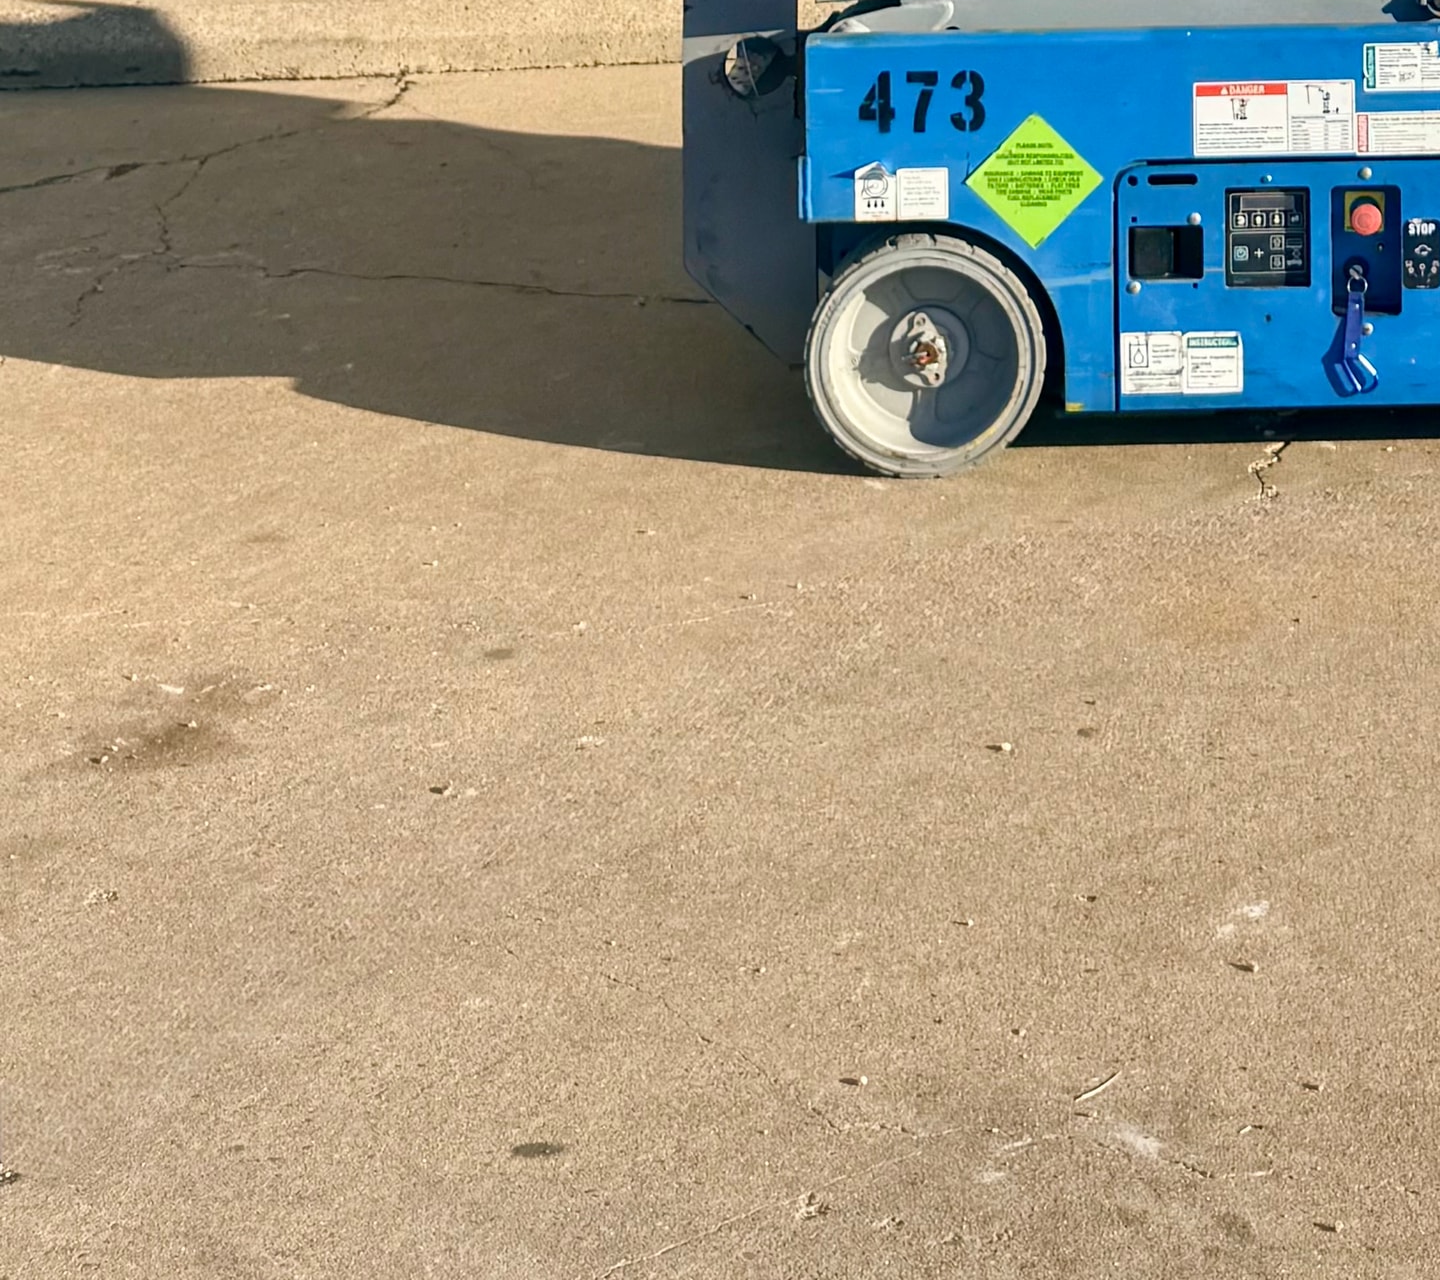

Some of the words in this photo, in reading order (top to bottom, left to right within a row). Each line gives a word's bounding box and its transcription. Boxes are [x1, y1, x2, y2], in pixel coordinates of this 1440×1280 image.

[1229, 85, 1265, 95] DANGER
[858, 70, 986, 133] 473
[1408, 223, 1436, 236] STOP
